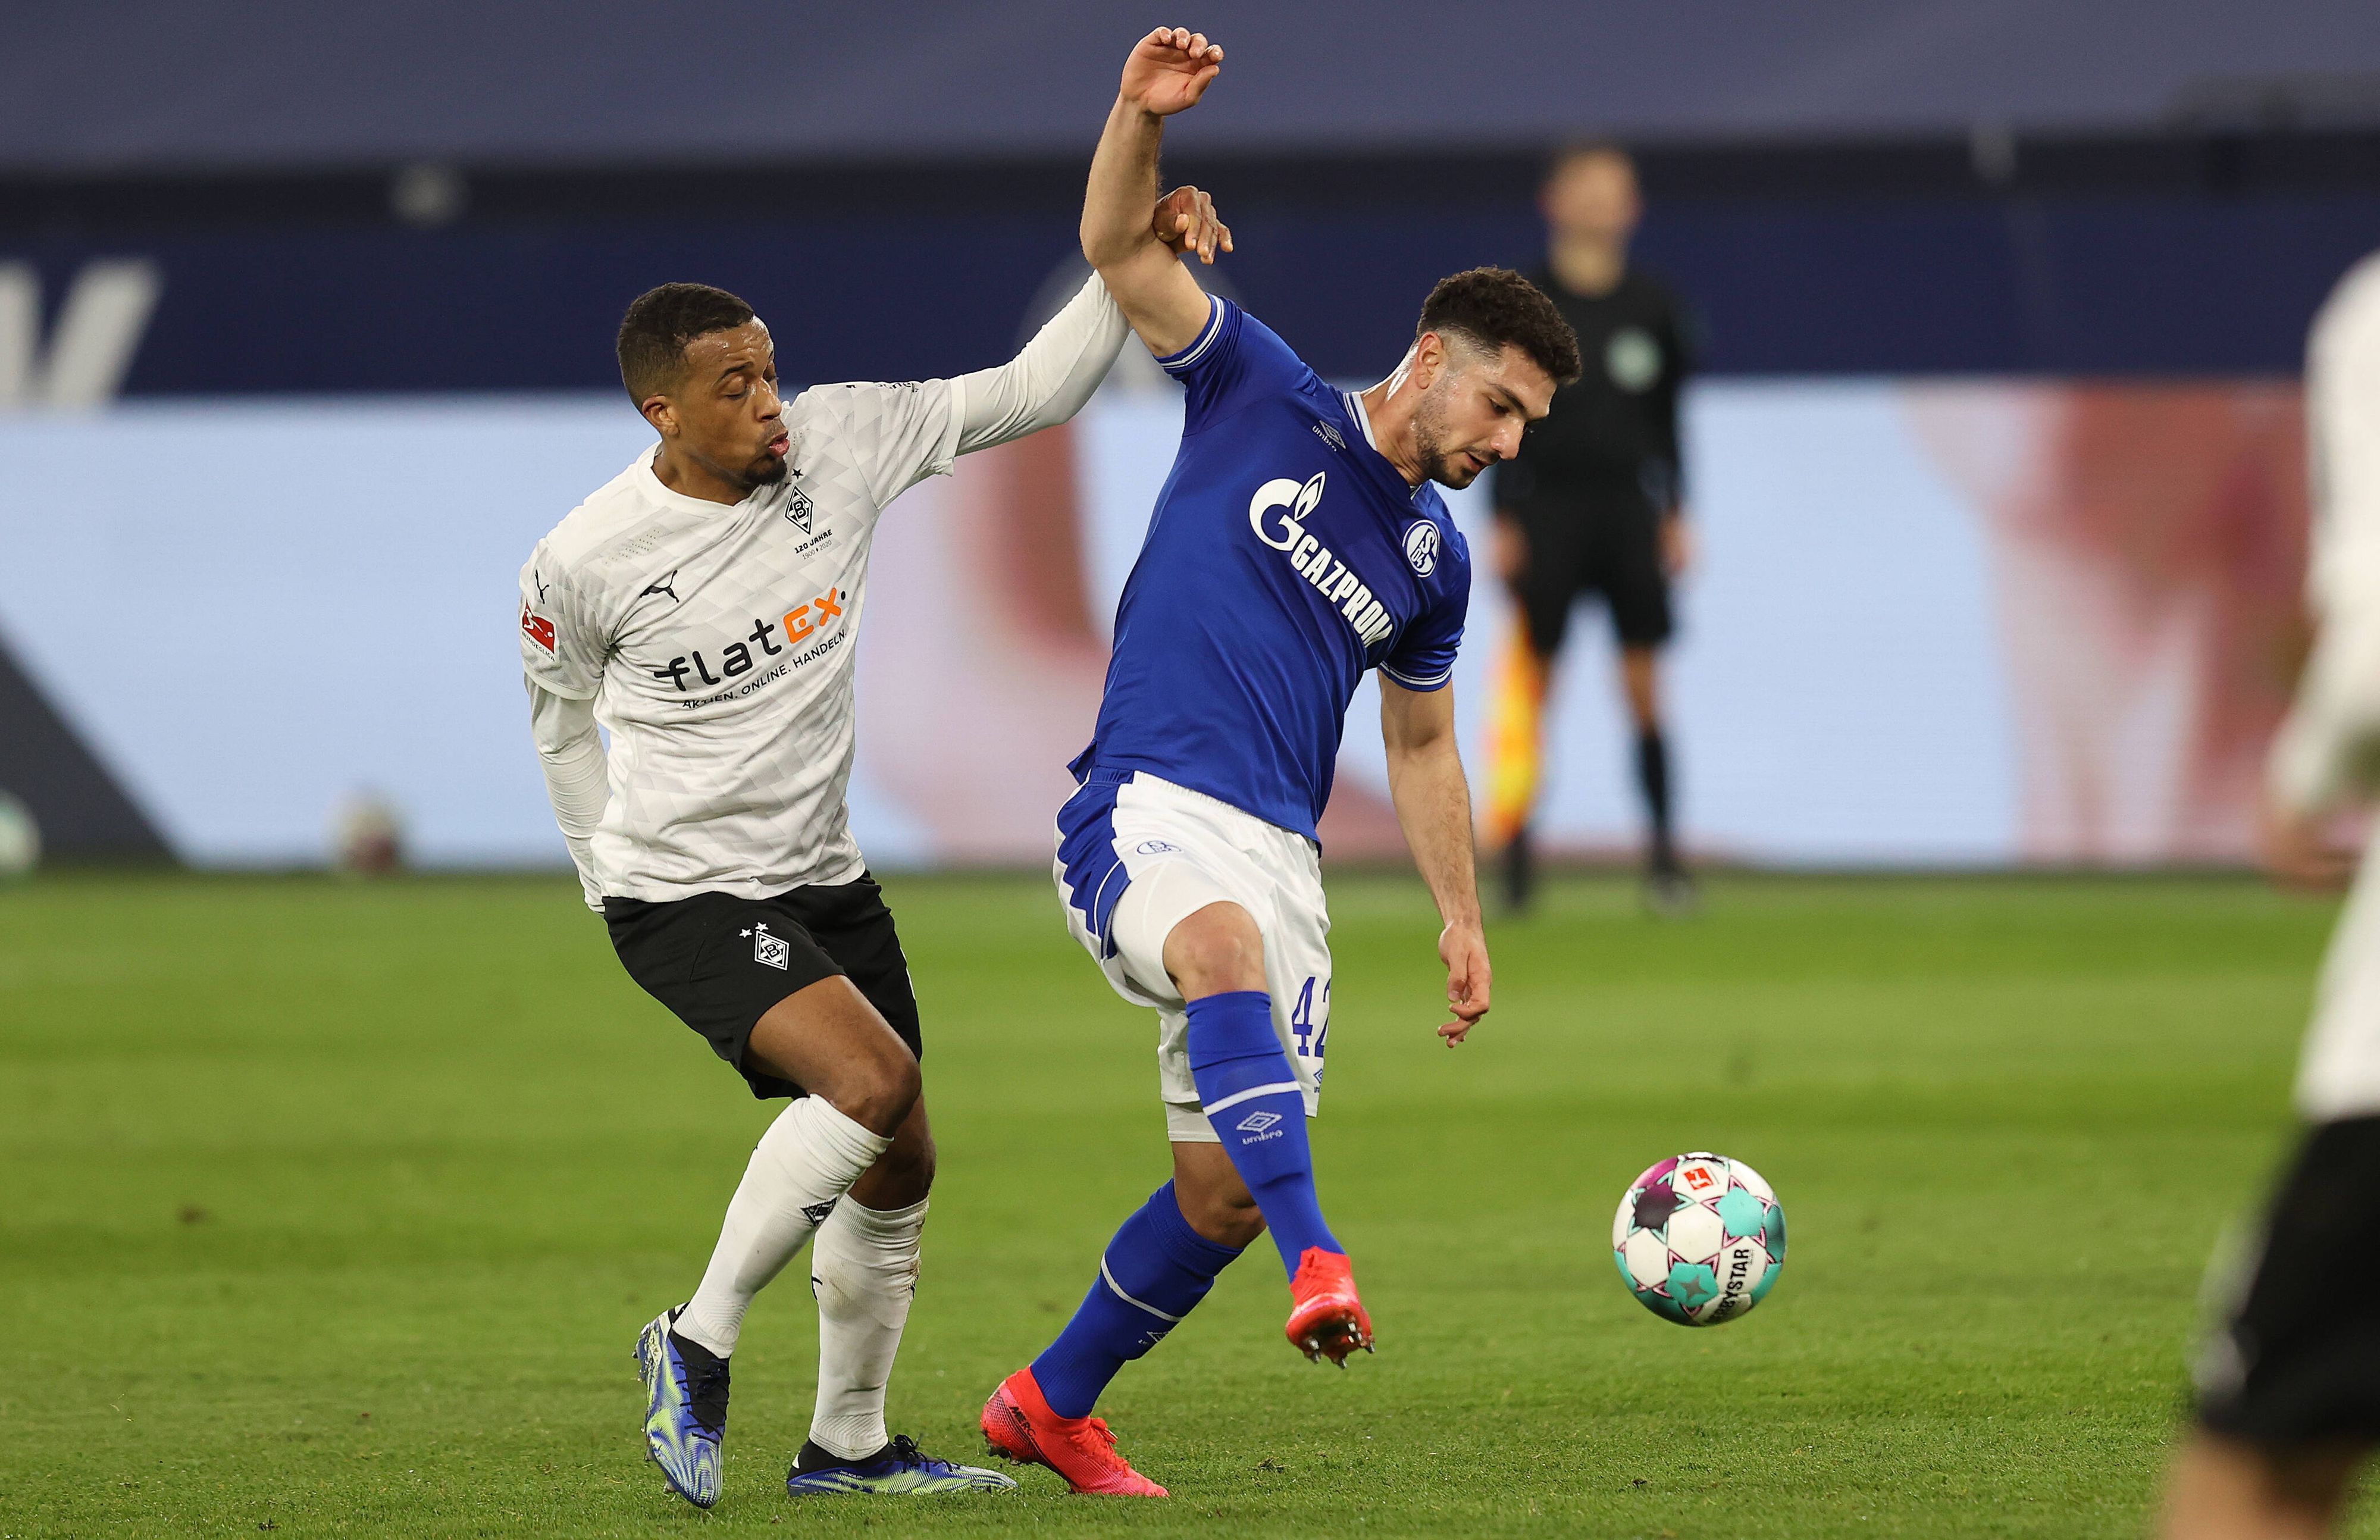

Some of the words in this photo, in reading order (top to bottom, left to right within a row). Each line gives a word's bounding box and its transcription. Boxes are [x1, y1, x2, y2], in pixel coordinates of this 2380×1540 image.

[794, 543, 809, 553] 120
[810, 529, 832, 546] JAHRE
[803, 549, 815, 559] 1900
[819, 540, 832, 550] 2020
[522, 631, 555, 662] BUNDESLIGA
[741, 663, 792, 695] ONLINE.
[793, 629, 847, 668] HANDELN.
[1242, 1129, 1283, 1145] umbro
